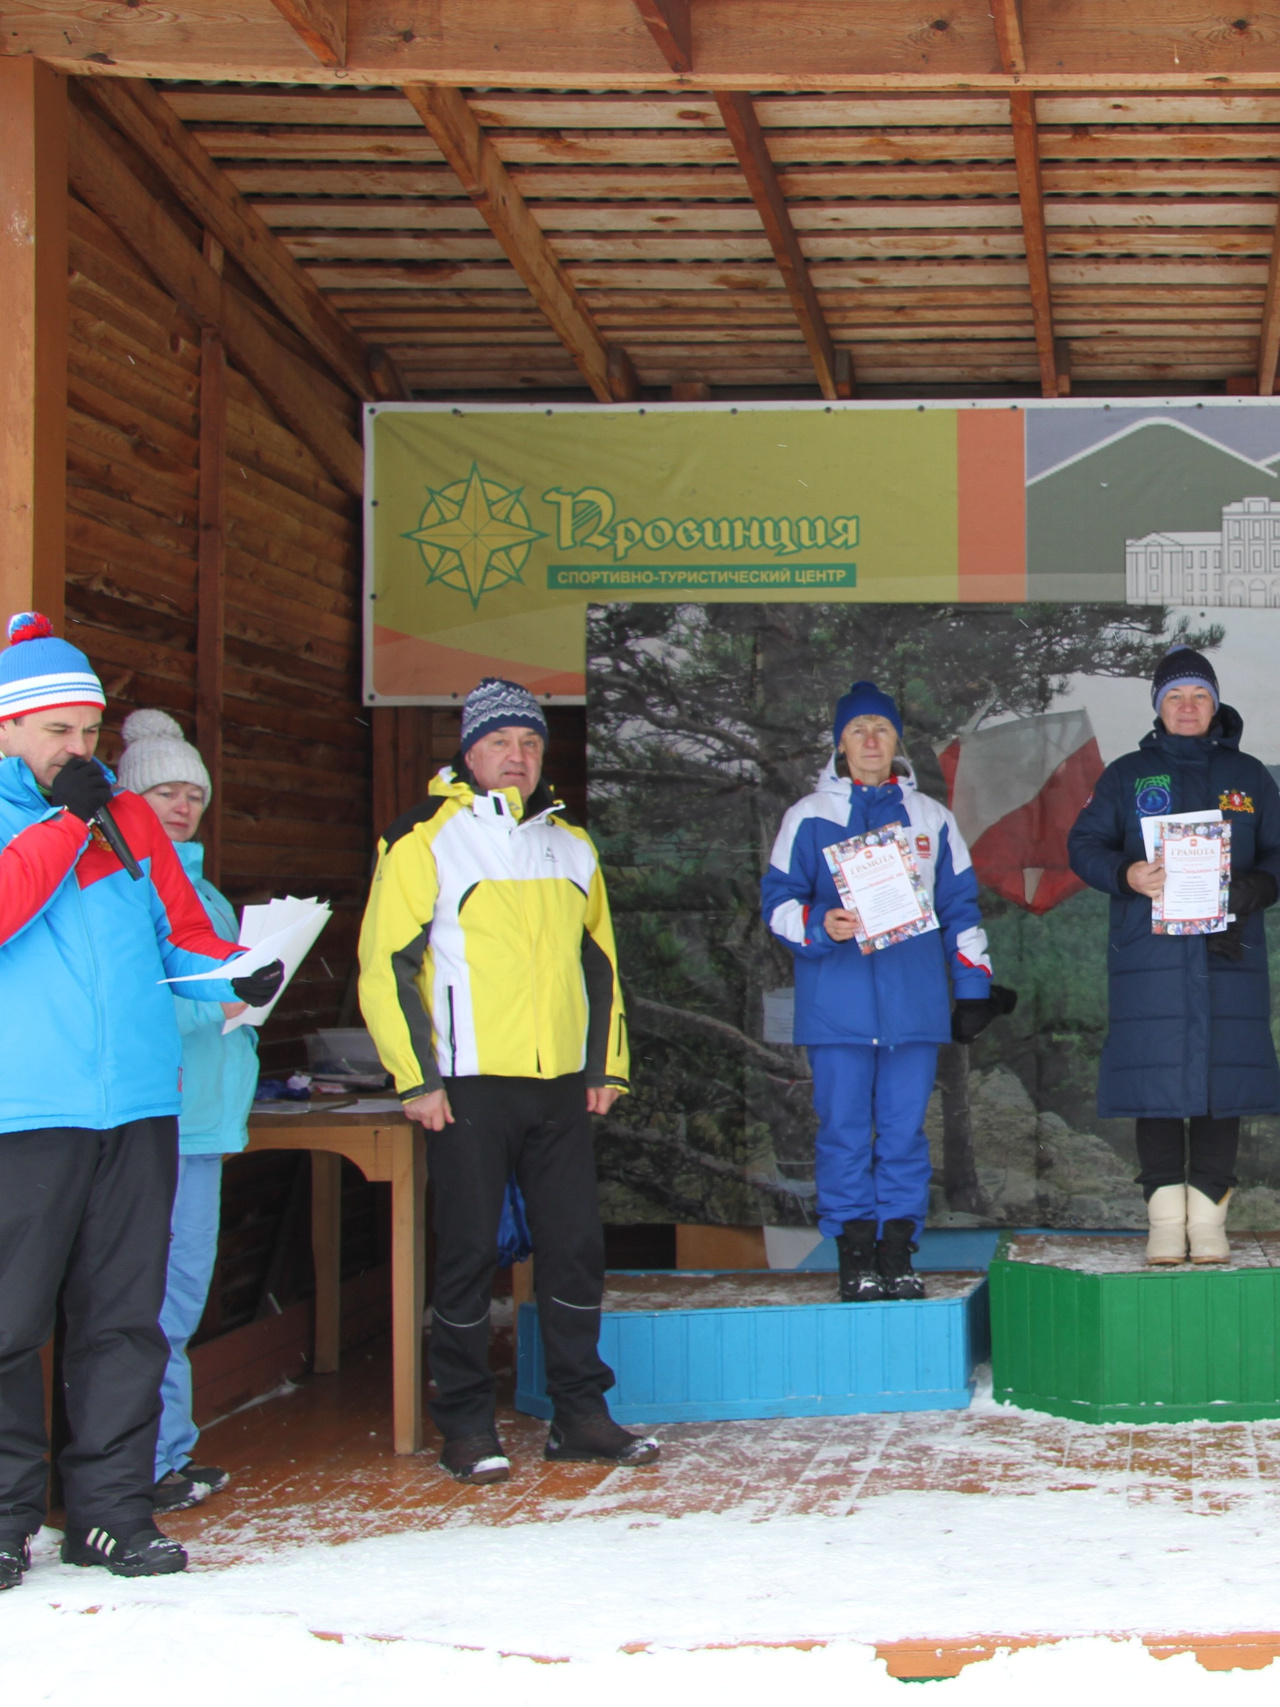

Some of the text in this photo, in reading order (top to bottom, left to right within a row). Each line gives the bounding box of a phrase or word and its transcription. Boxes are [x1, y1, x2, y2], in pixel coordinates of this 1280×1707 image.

[541, 486, 860, 562] Провинция
[557, 567, 847, 585] СПОРТИВНО-ТУРИСТИЧЕСКИЙ ЦЕНТР
[1171, 848, 1215, 856] ГРАМОТА
[850, 853, 895, 875] ГРАМОТА
